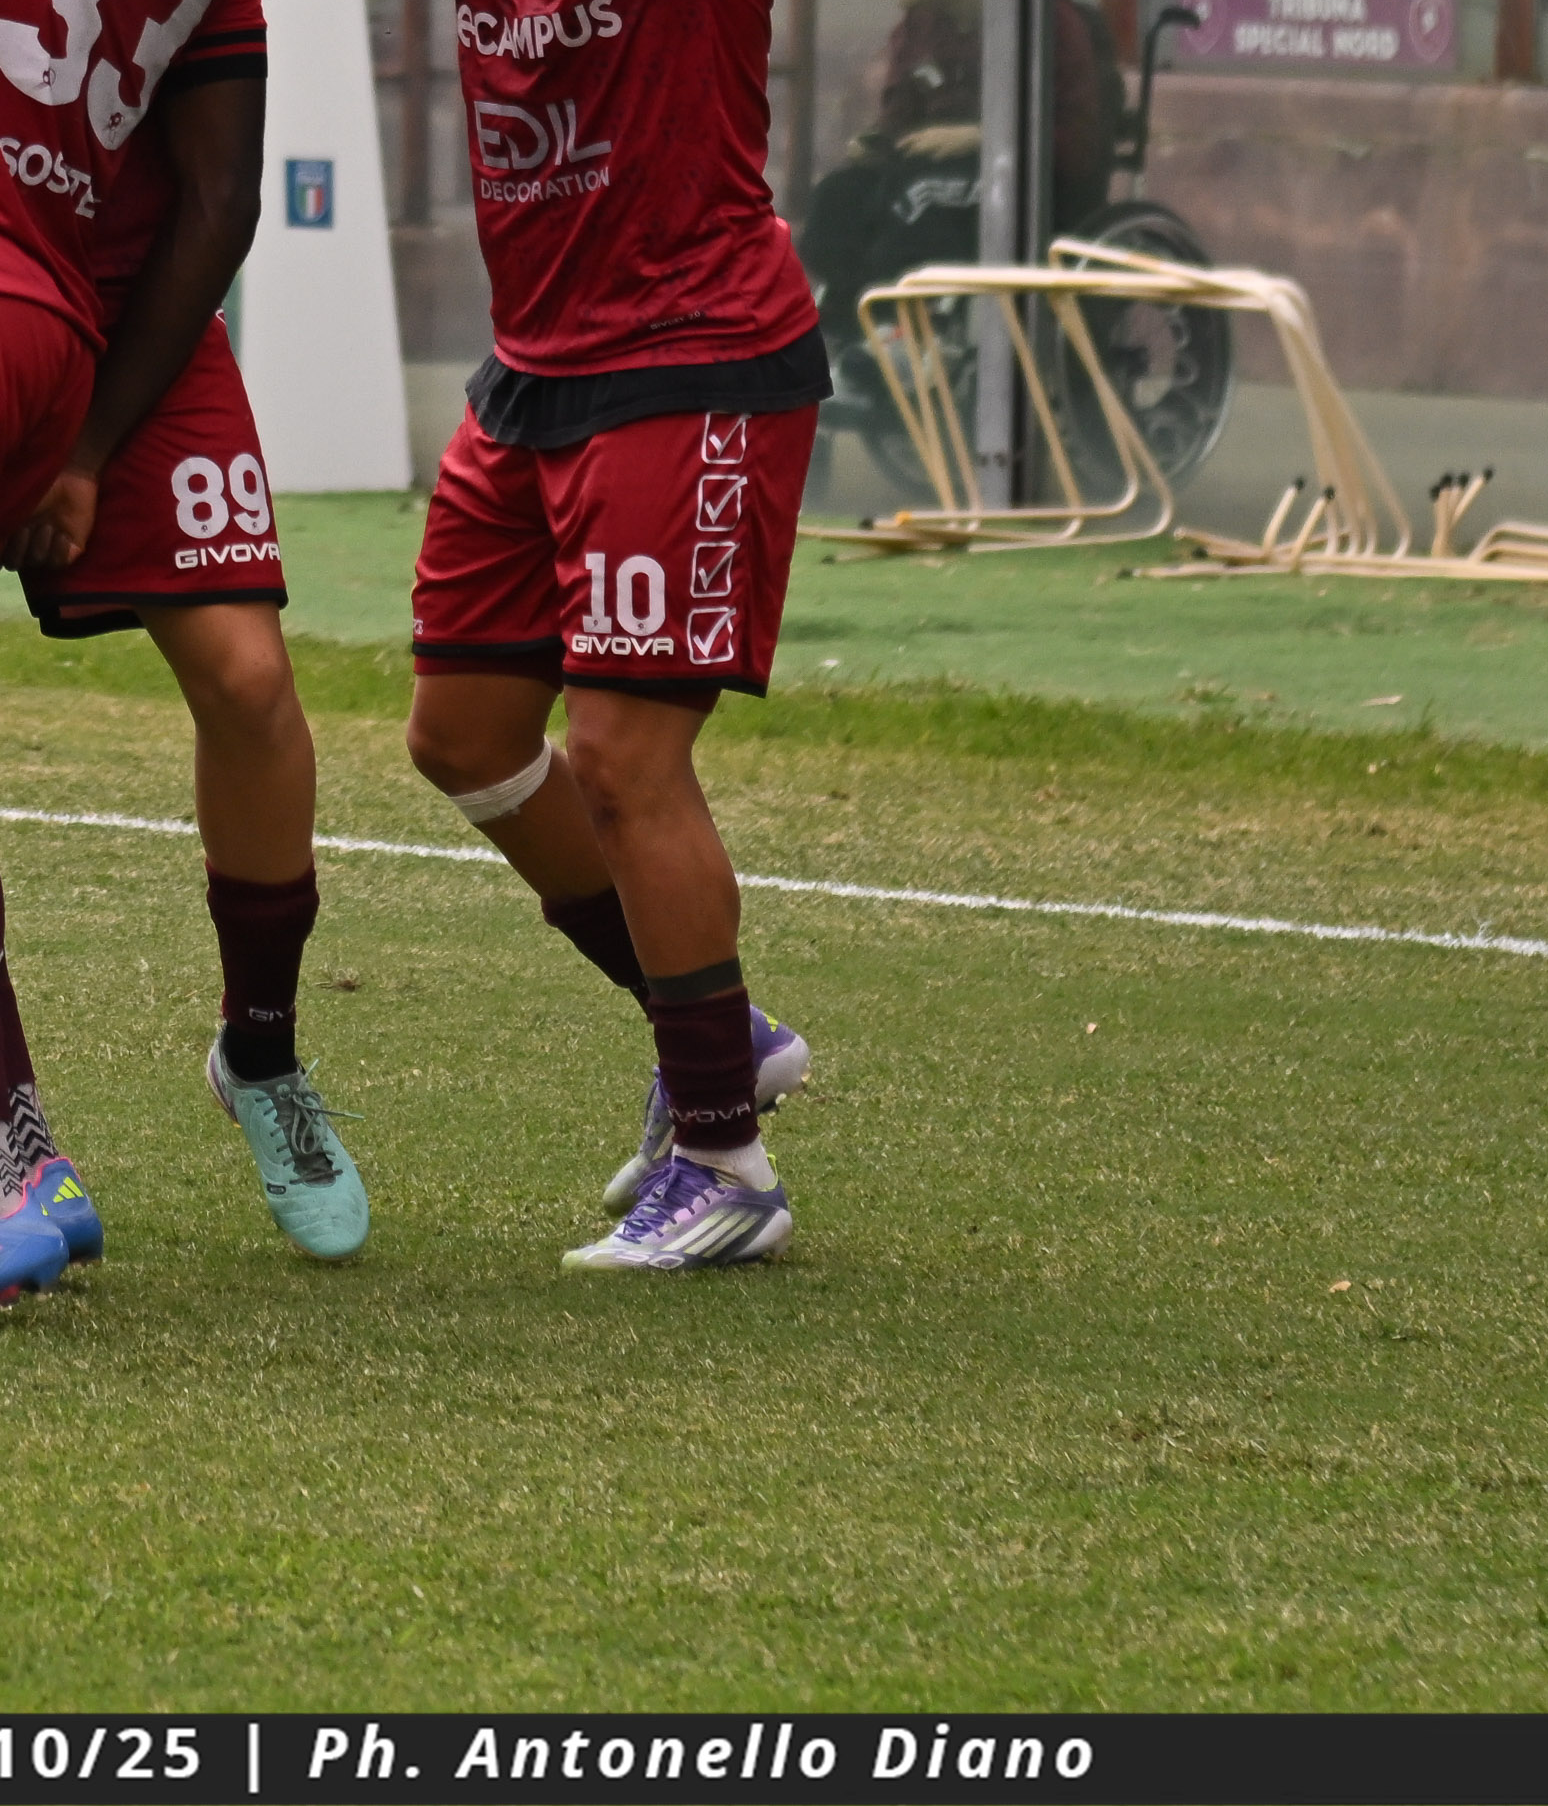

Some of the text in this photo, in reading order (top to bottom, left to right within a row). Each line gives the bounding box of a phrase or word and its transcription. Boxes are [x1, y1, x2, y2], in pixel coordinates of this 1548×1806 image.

[1235, 23, 1400, 61] SPECIAL NORD
[474, 99, 612, 170] EDIL
[481, 167, 610, 203] DECORATION
[171, 453, 271, 539] 89
[175, 541, 280, 570] GIVOVA
[582, 552, 666, 637] 10
[571, 634, 674, 657] GIVOVA
